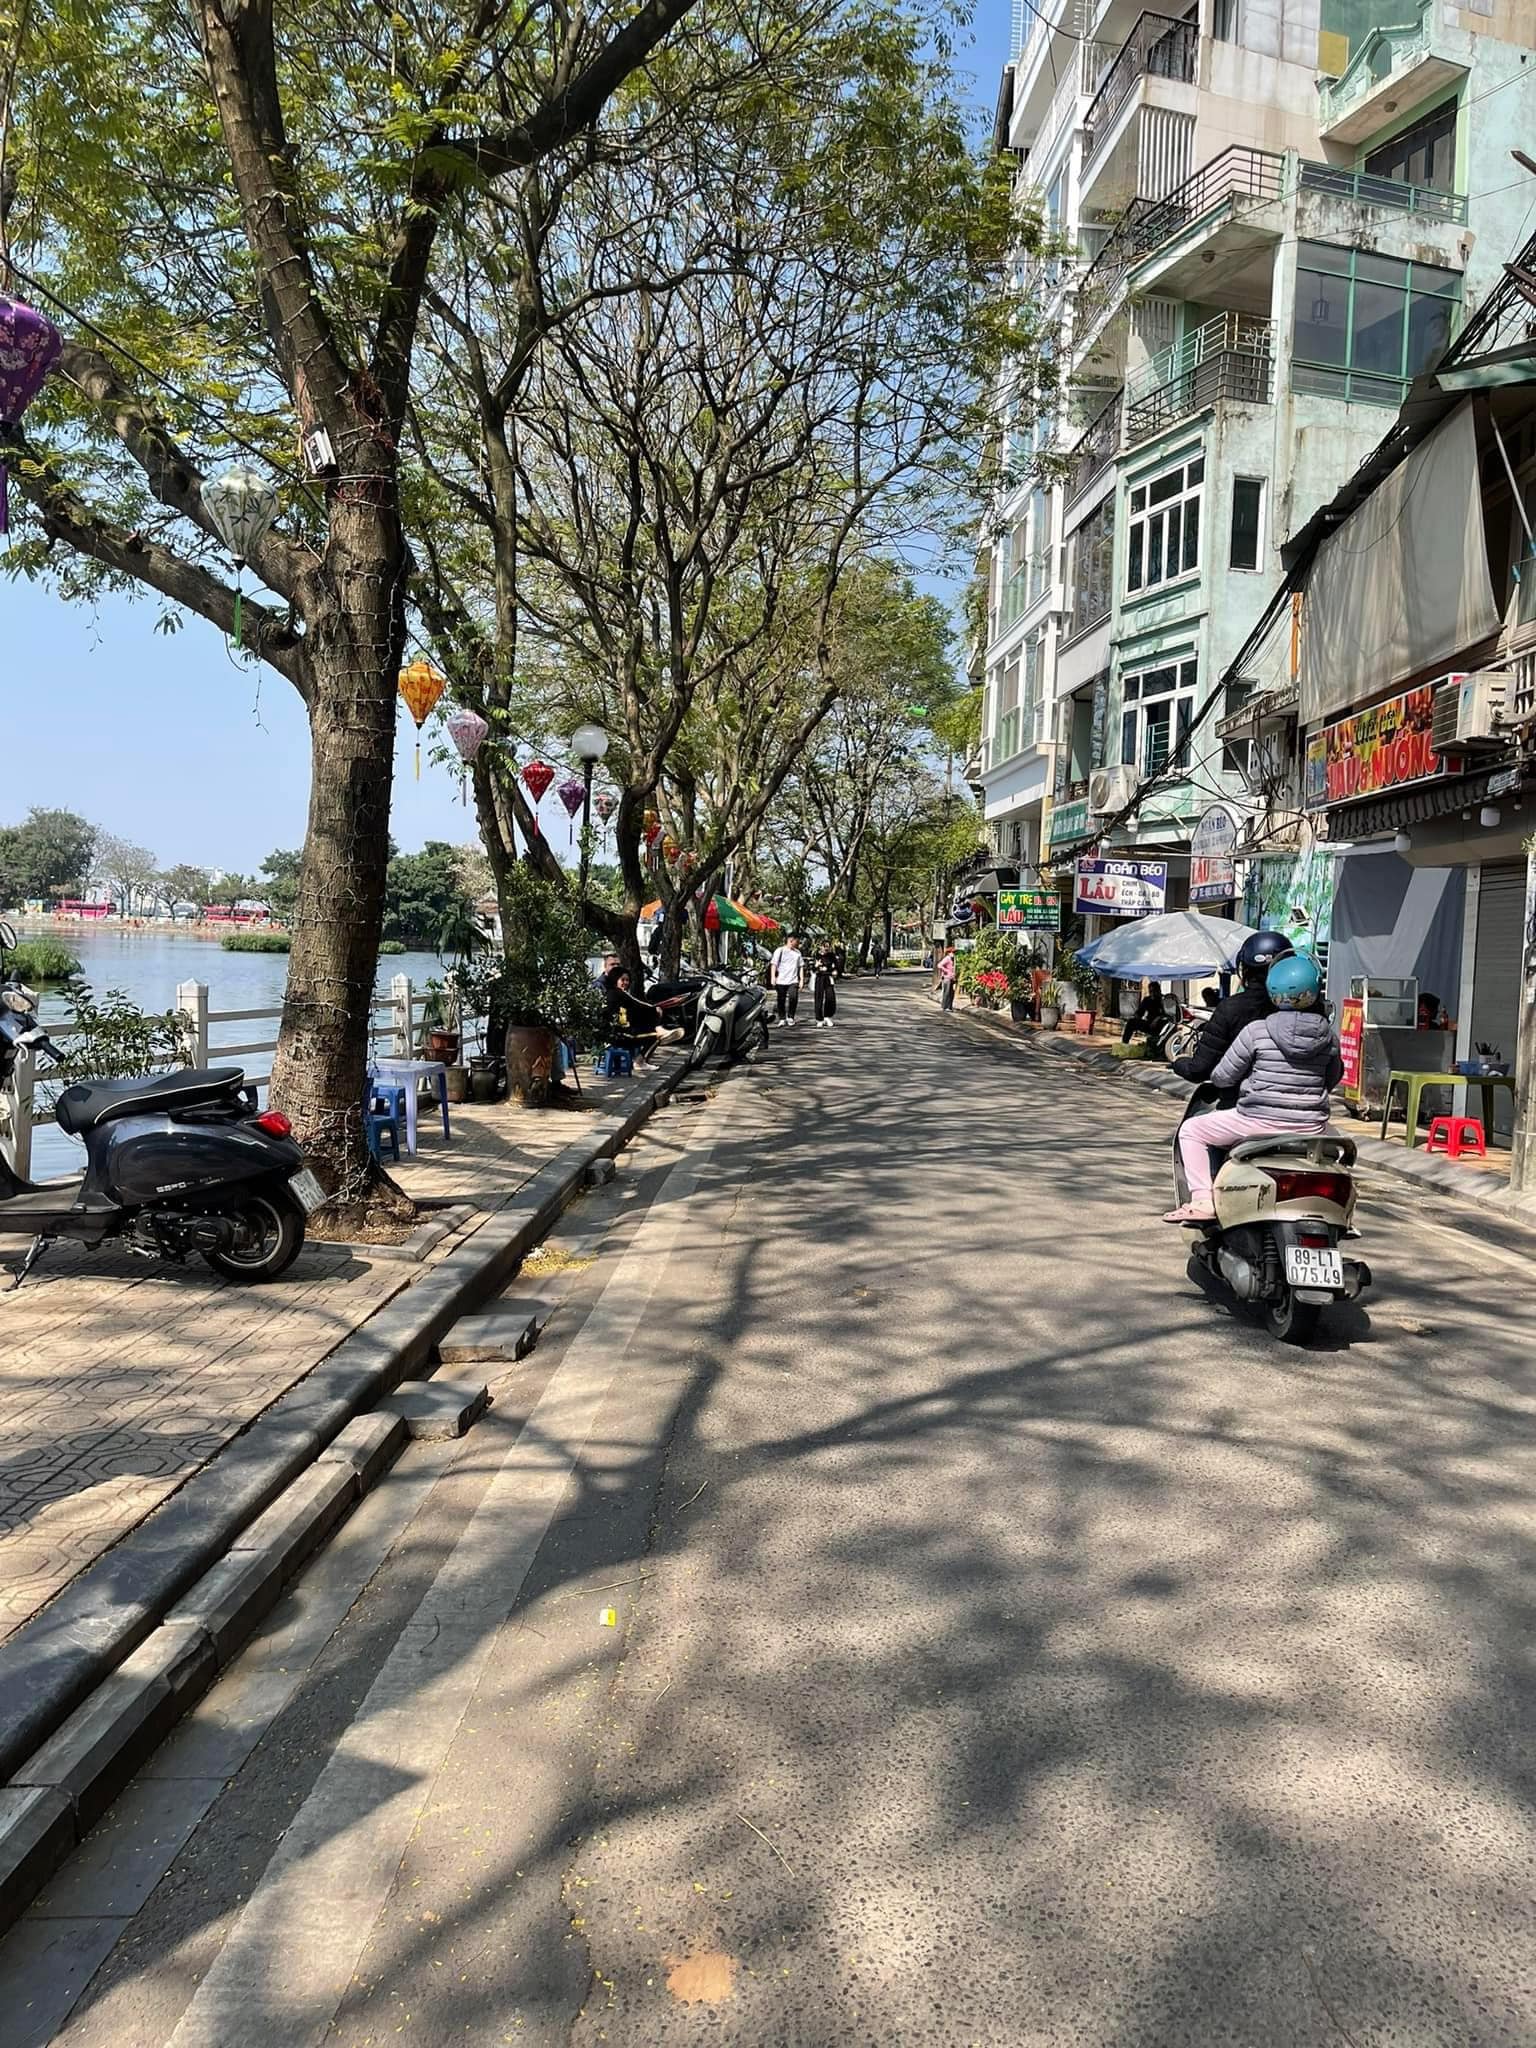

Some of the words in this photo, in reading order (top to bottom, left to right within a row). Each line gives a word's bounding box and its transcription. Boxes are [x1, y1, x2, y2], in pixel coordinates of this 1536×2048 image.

[1104, 861, 1138, 875] NGÂN
[1140, 862, 1163, 876] BÉO
[1080, 877, 1116, 899] LẨU
[1019, 894, 1033, 905] TRE
[1295, 1249, 1333, 1267] 89-L1
[1291, 1266, 1341, 1284] 075.49
